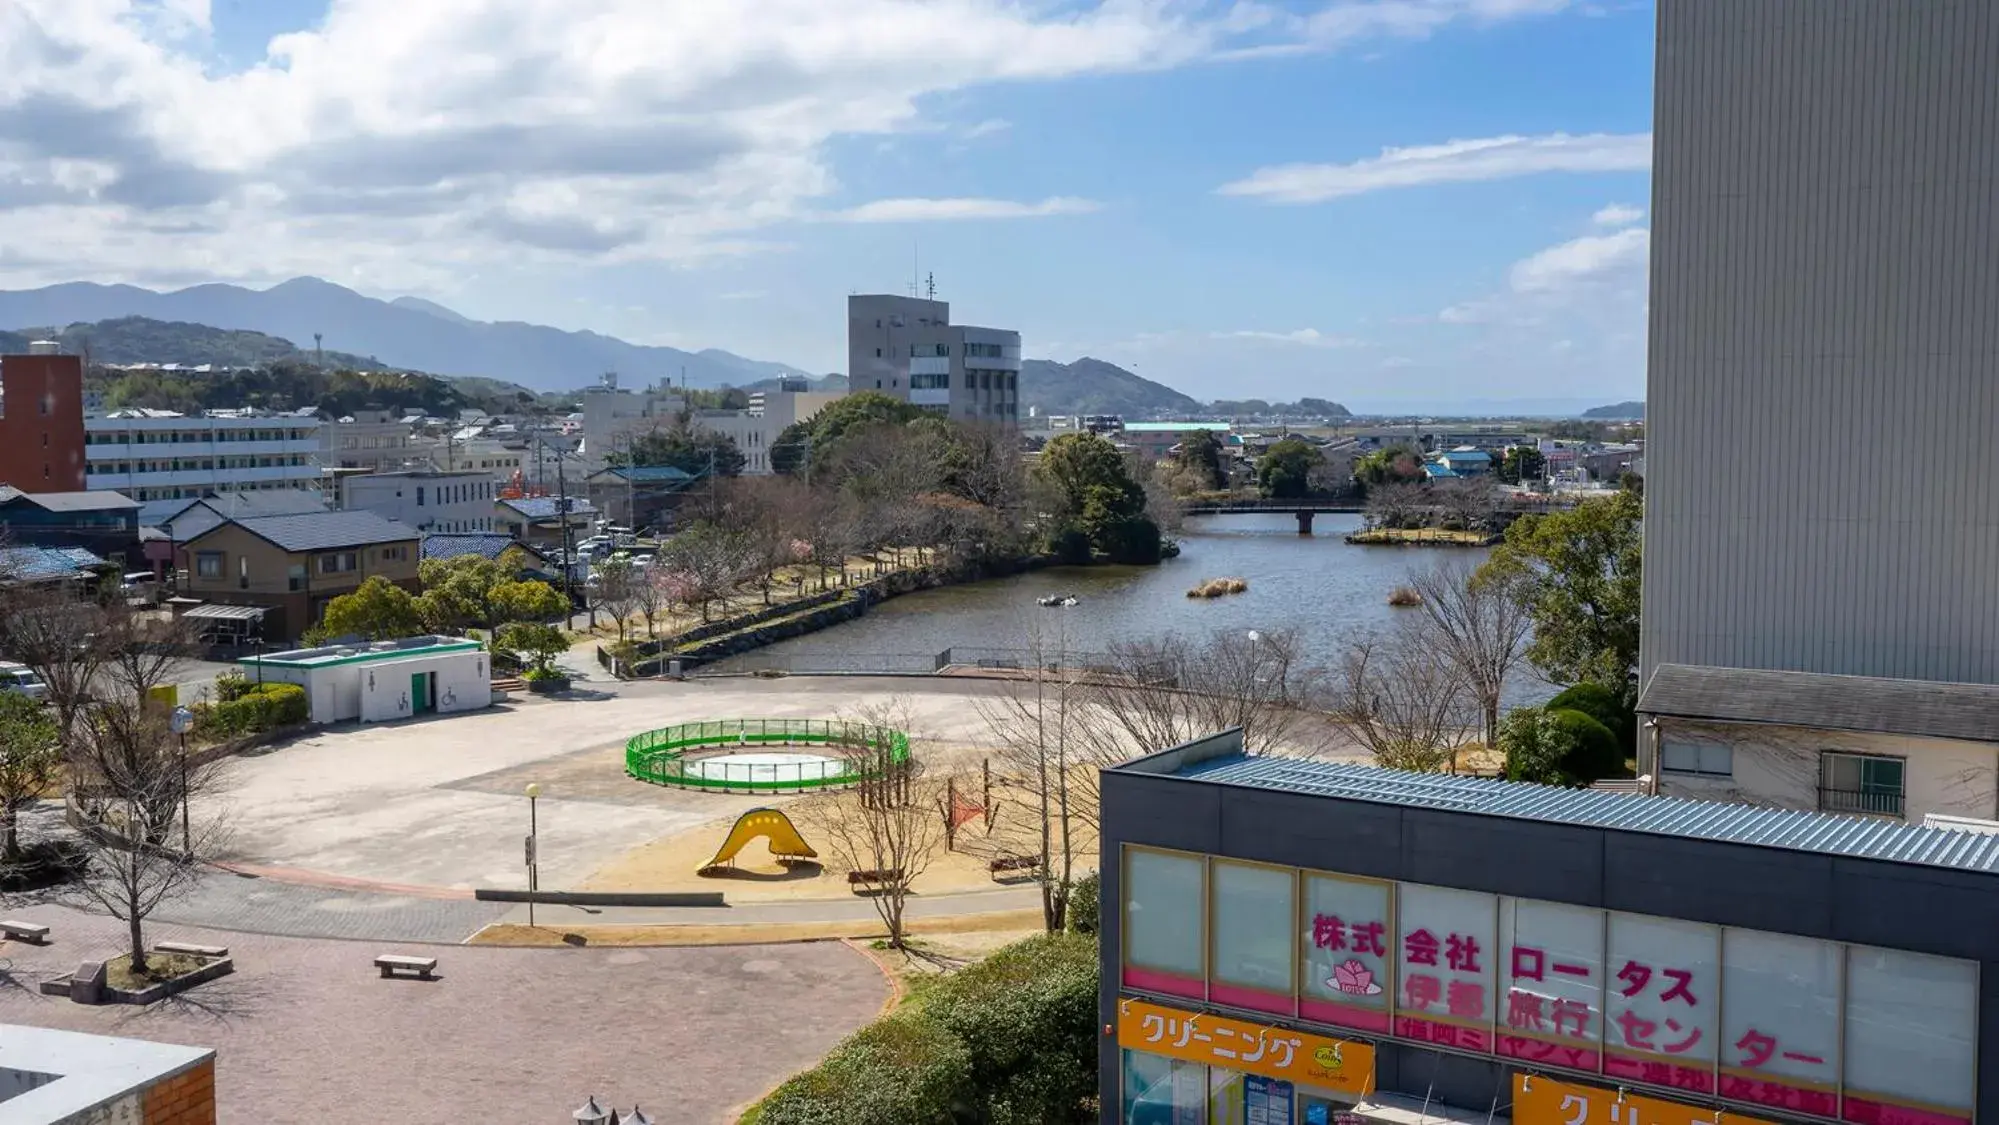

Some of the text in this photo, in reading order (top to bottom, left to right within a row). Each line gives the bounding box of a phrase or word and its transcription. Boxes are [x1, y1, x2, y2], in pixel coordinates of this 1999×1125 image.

[1142, 1014, 1302, 1068] クリーニング
